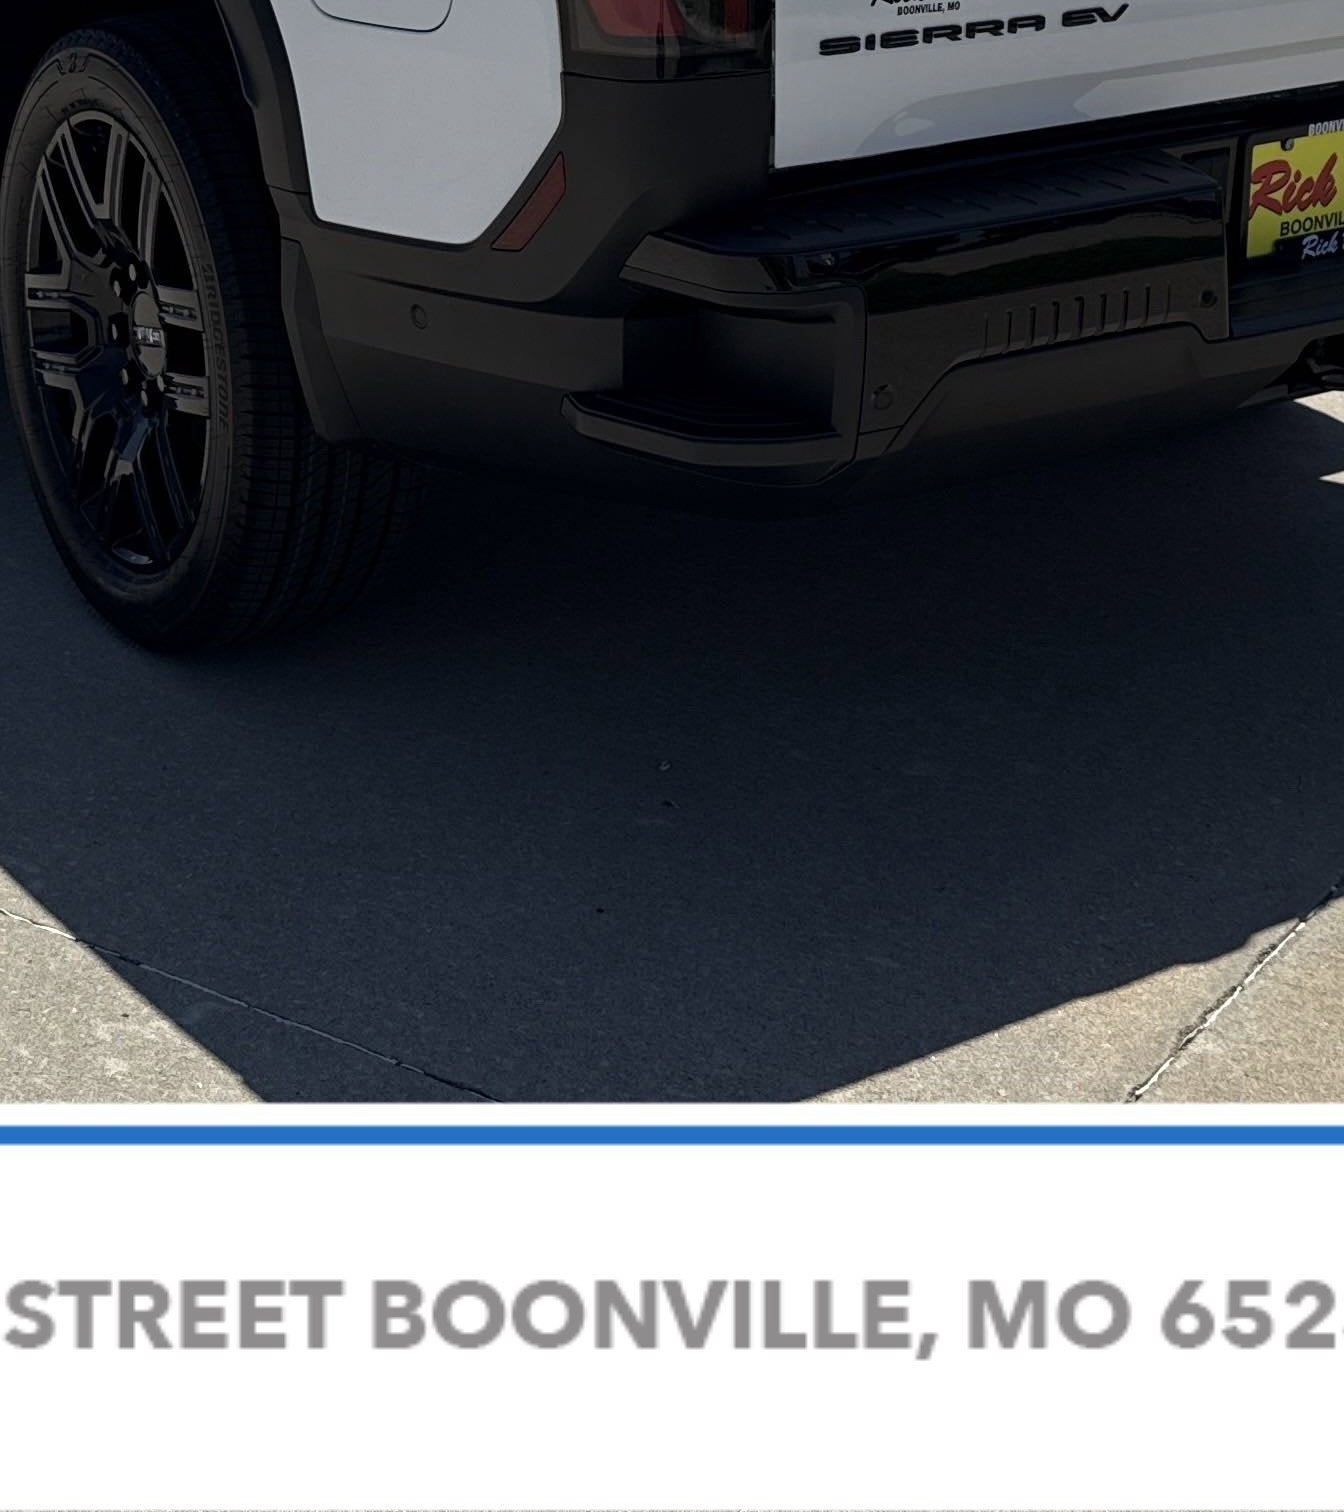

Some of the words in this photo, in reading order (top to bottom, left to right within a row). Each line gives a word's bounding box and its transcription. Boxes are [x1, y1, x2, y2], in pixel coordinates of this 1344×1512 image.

[819, 14, 1046, 56] SIERRA
[1061, 3, 1129, 27] EV
[897, 2, 945, 16] BOONVILLE,
[947, 1, 961, 11] MO
[1249, 153, 1338, 221] Rick
[1302, 232, 1339, 260] Rick
[201, 264, 230, 433] BRIDGESTONE
